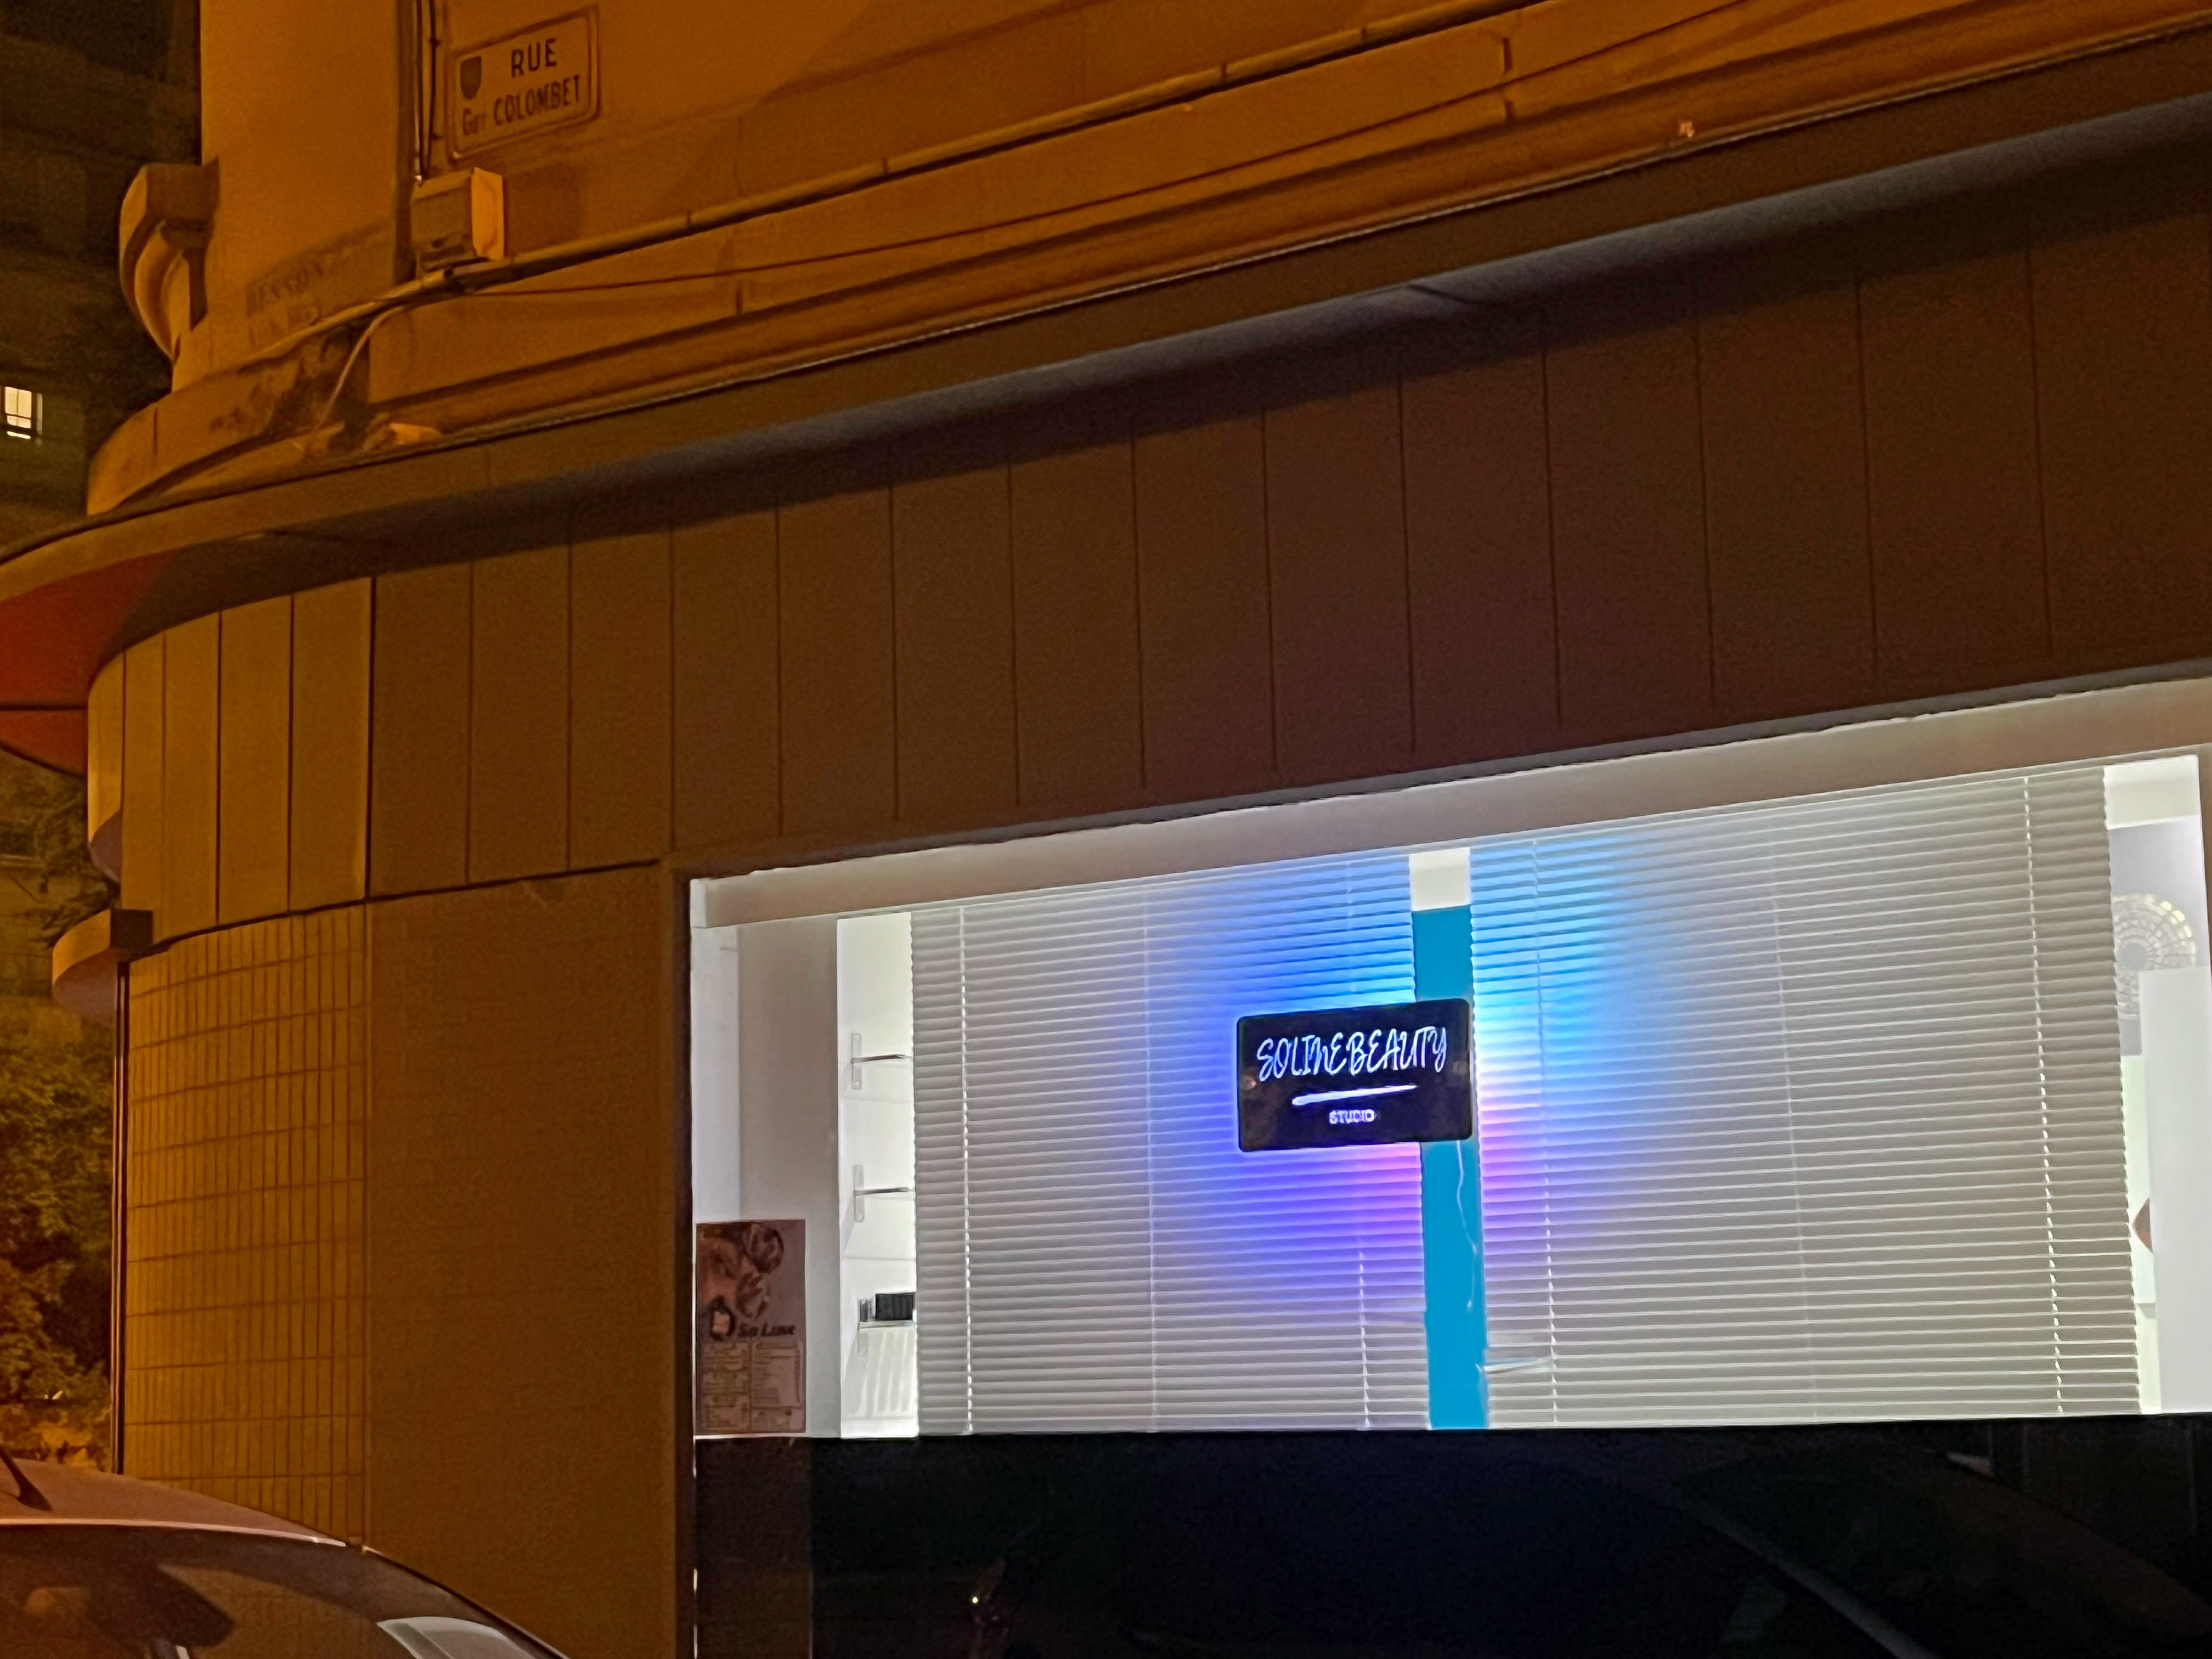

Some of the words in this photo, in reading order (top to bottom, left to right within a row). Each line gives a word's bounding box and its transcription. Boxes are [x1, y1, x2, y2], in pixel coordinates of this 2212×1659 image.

[511, 38, 557, 78] RUE
[493, 74, 580, 126] COLOMBET
[1329, 1109, 1377, 1125] STUDIO
